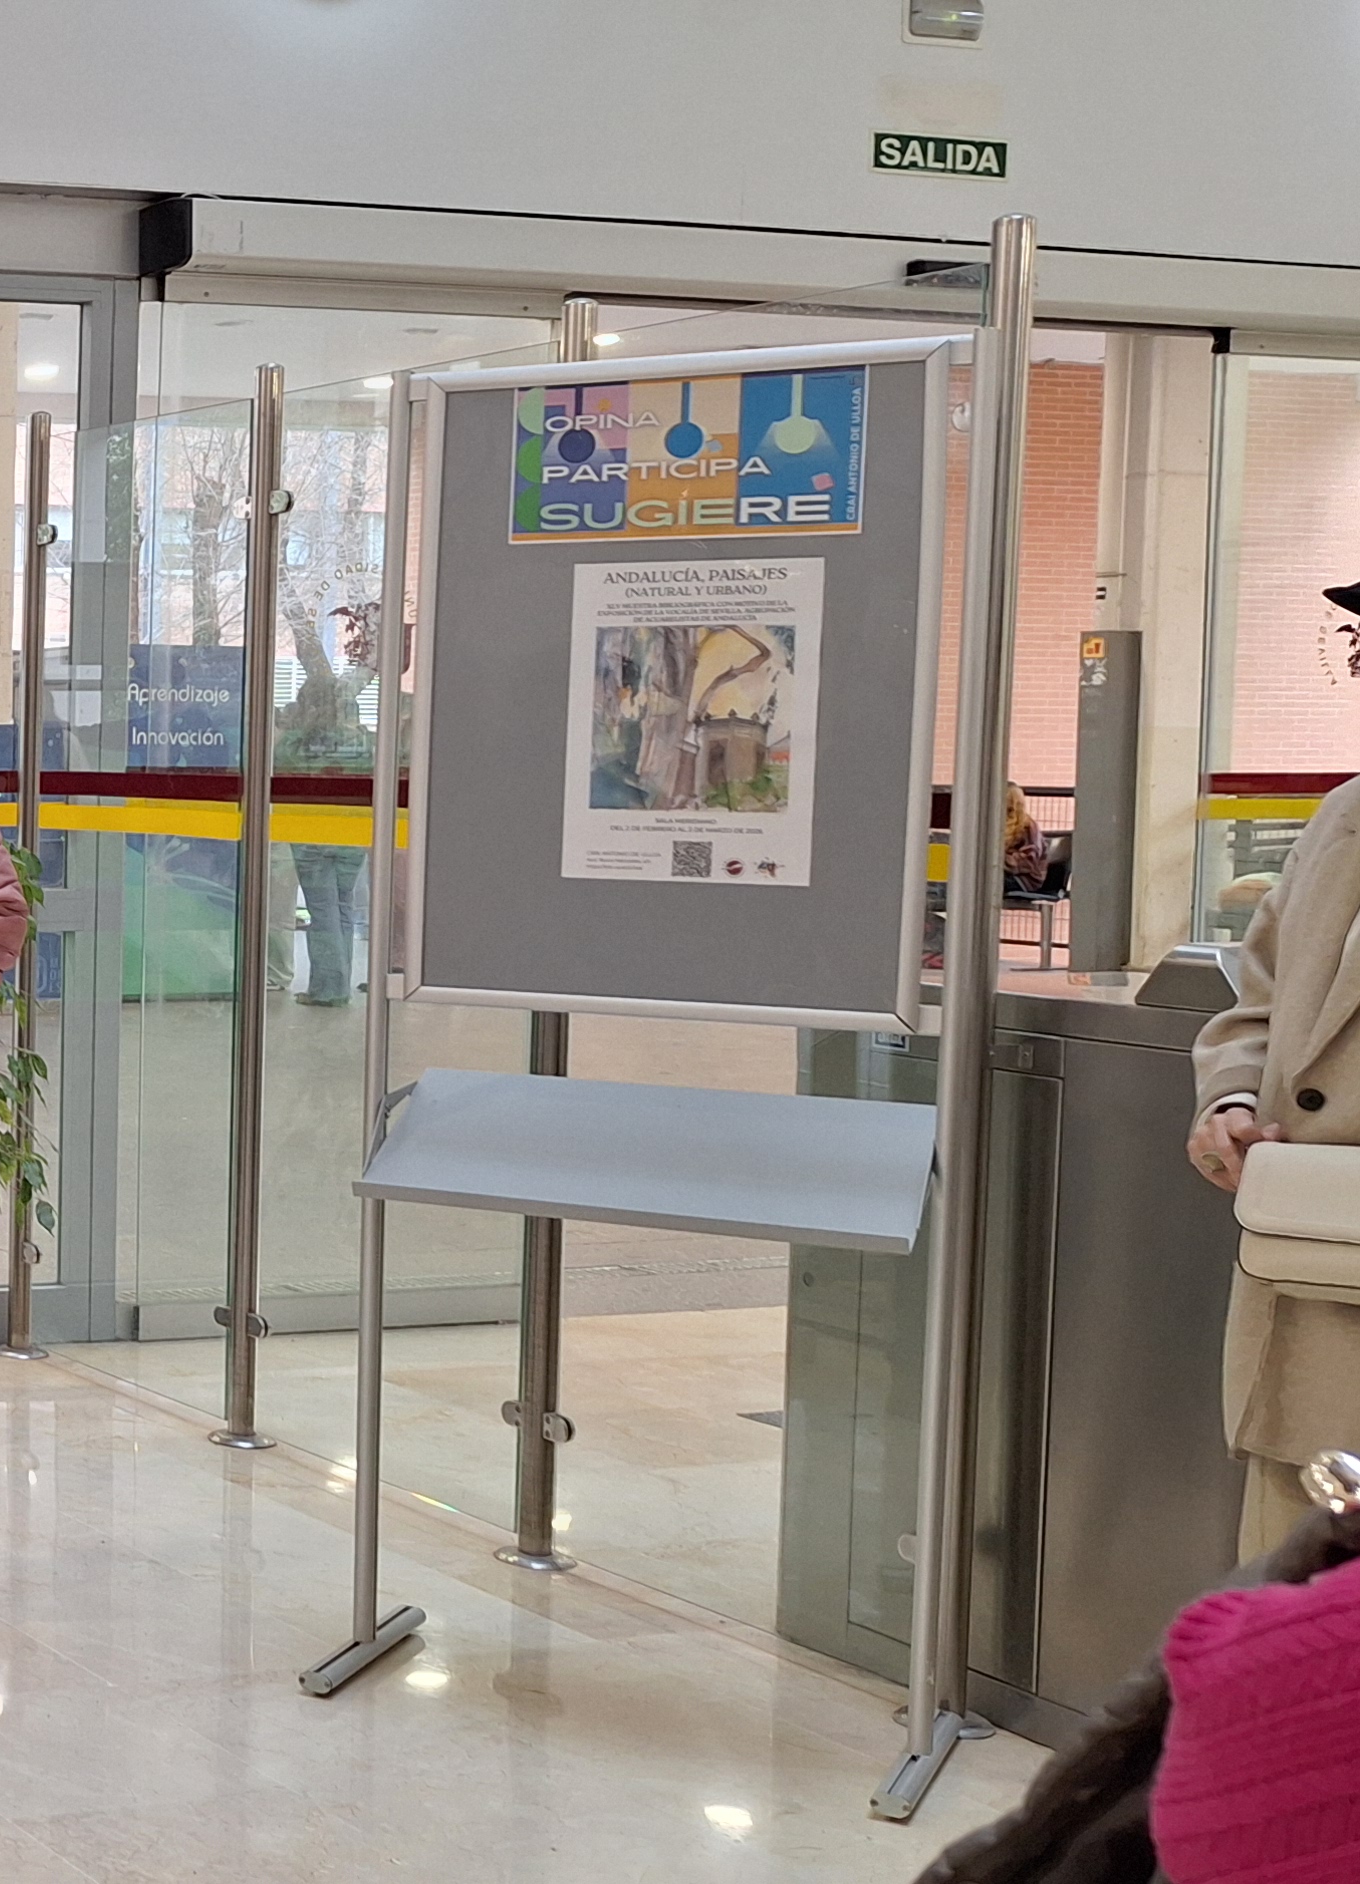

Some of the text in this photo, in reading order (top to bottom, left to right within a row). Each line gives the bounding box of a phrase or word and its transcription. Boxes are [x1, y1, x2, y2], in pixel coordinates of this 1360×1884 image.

[879, 137, 1001, 174] SALIDA
[851, 387, 862, 424] ULLOA
[544, 411, 660, 433] OPINA
[850, 425, 860, 441] DE
[541, 456, 772, 484] PARTICIPA
[847, 443, 859, 493] ANTONIO
[539, 494, 831, 532] SUGIERE
[603, 567, 788, 584] ANDALUCÍA, PAISAJES
[625, 584, 767, 599] (NATURAL Y URBANO)
[127, 683, 231, 707] Aprendizaje
[131, 726, 224, 746] Innovación
